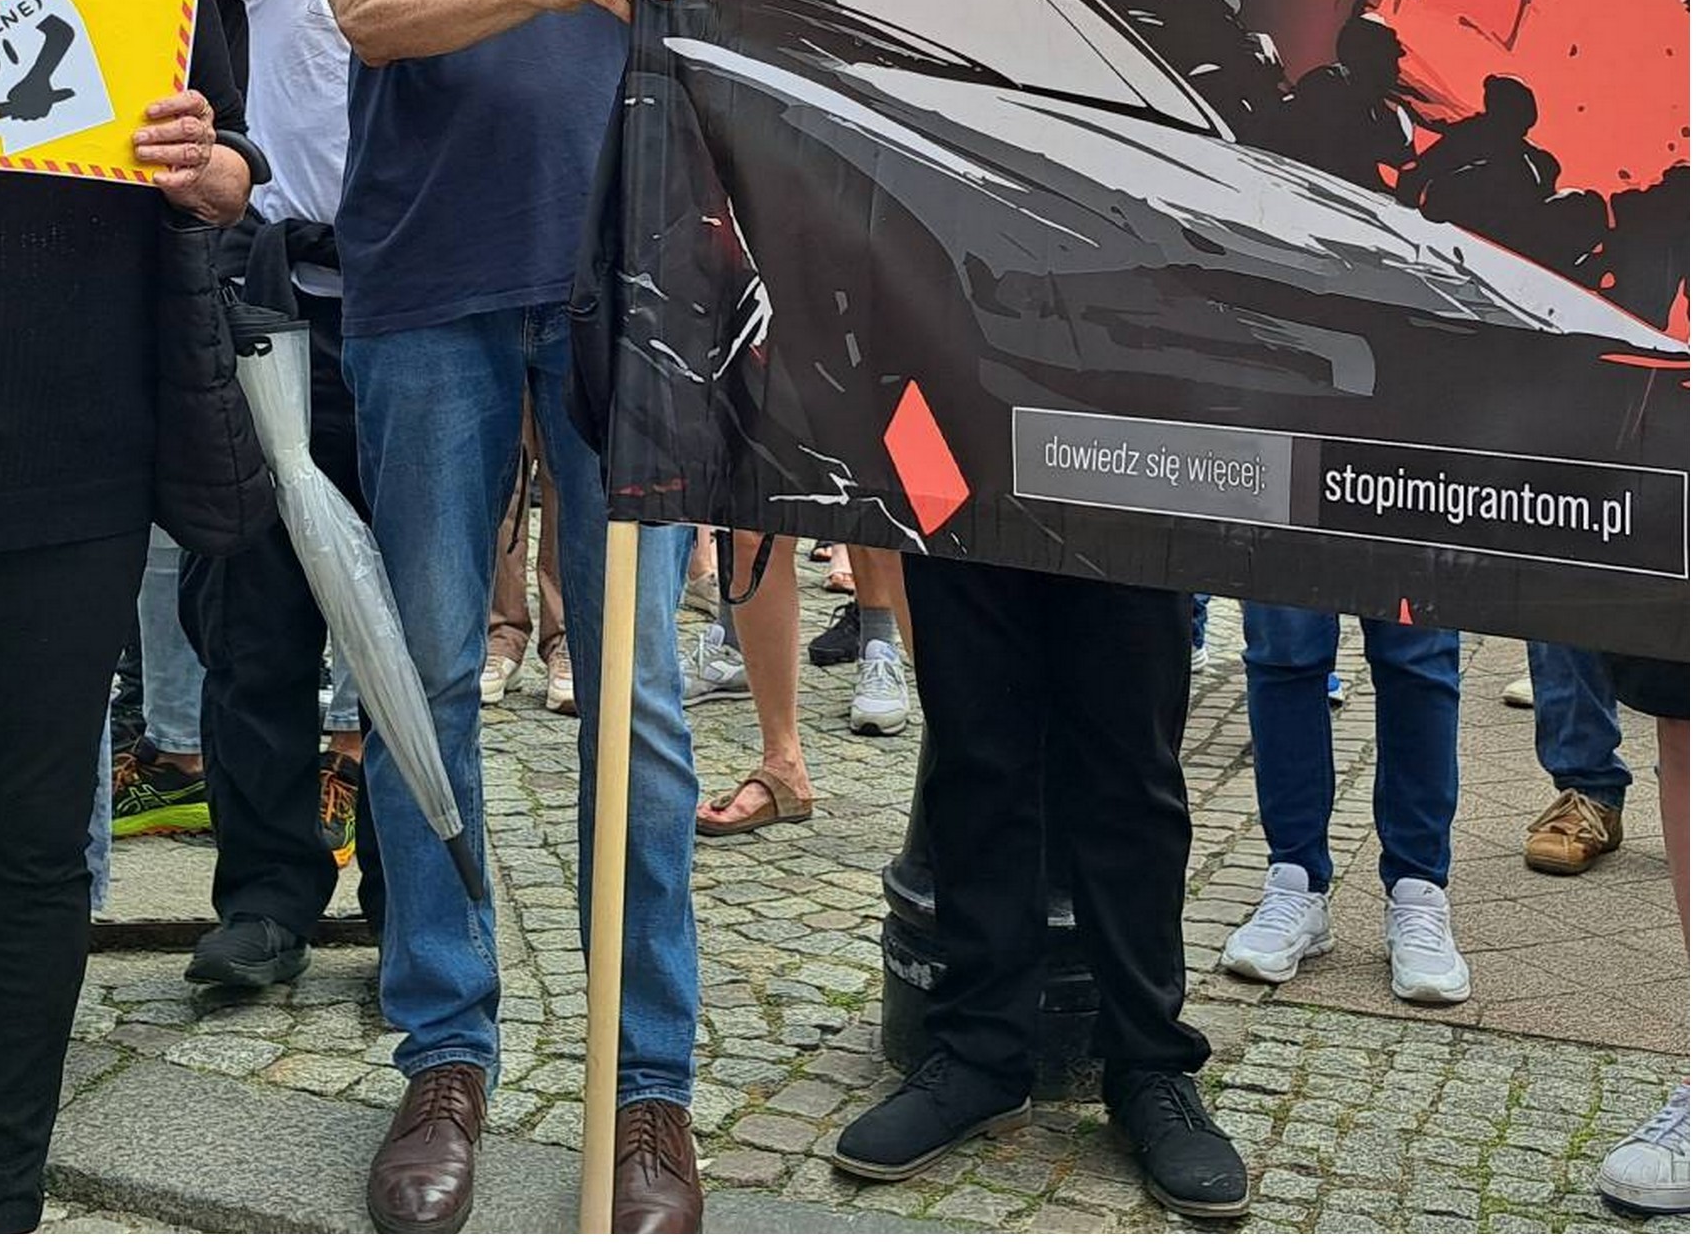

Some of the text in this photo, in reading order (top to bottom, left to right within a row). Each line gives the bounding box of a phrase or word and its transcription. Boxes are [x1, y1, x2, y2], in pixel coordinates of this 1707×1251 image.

[1044, 436, 1267, 494] dowiedz się więcej:
[1324, 466, 1632, 541] stopimigrantom.pl
